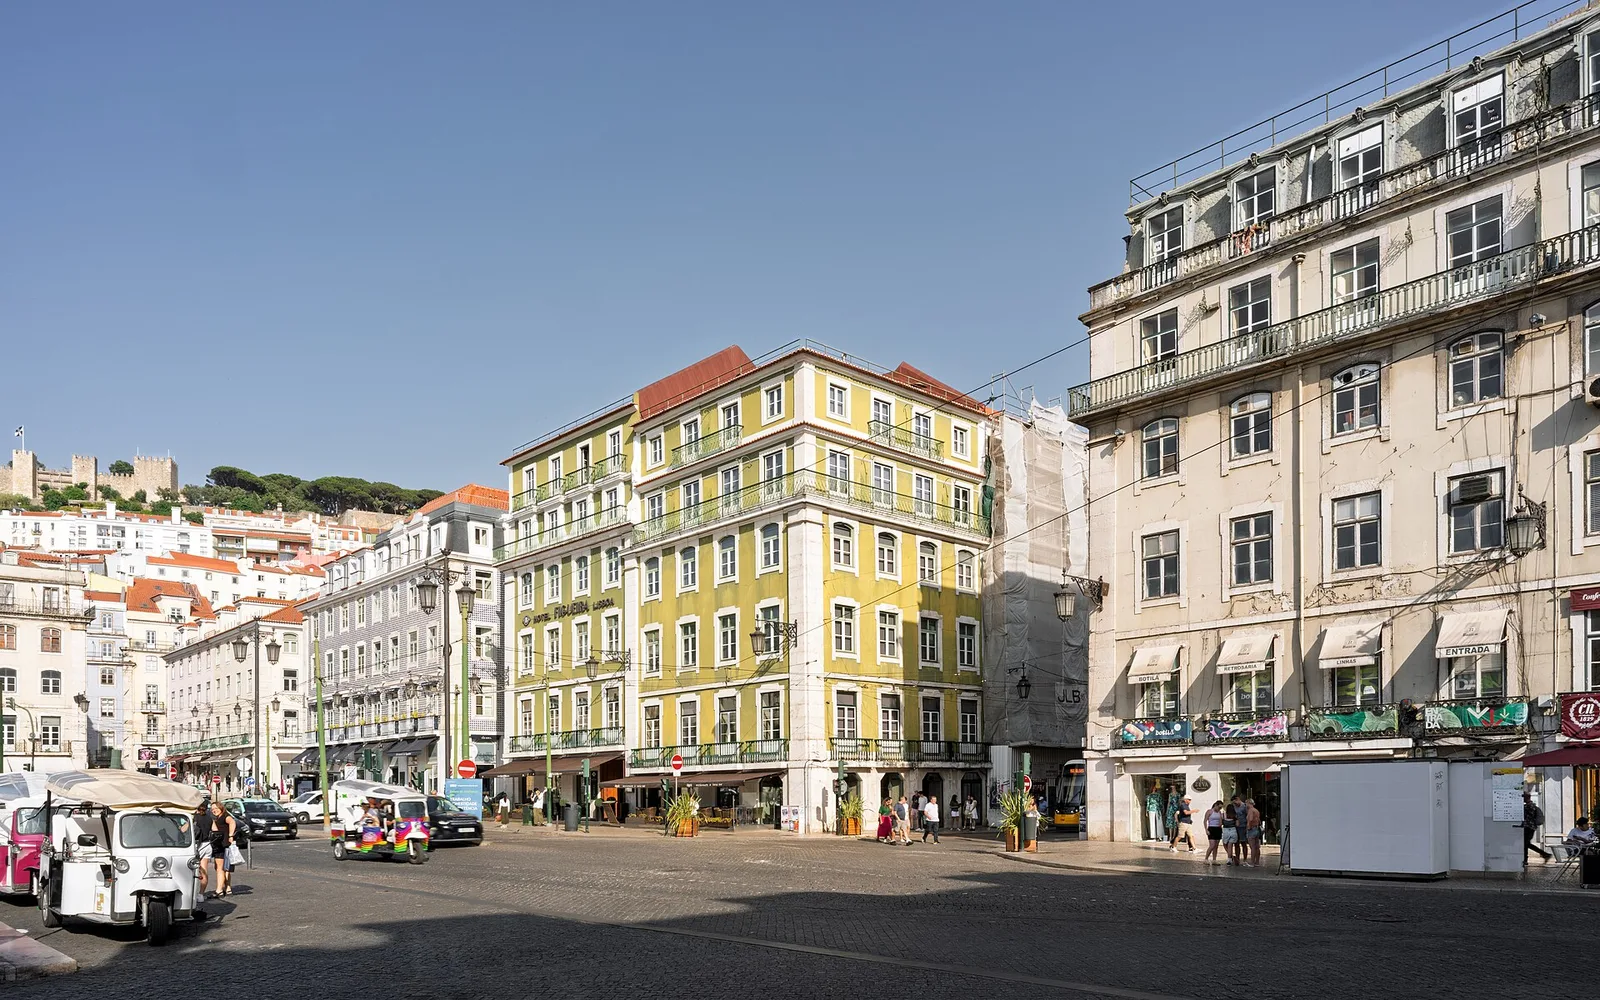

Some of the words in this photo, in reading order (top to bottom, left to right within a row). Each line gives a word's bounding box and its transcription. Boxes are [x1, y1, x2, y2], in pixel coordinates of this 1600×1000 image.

[533, 613, 551, 624] HOTEL
[554, 600, 590, 619] FIGUEIRA
[592, 598, 614, 611] LISBOA
[1445, 646, 1490, 656] ENTRADA
[1057, 689, 1080, 703] JLB
[1425, 707, 1439, 715] EN
[1426, 721, 1440, 729] DA
